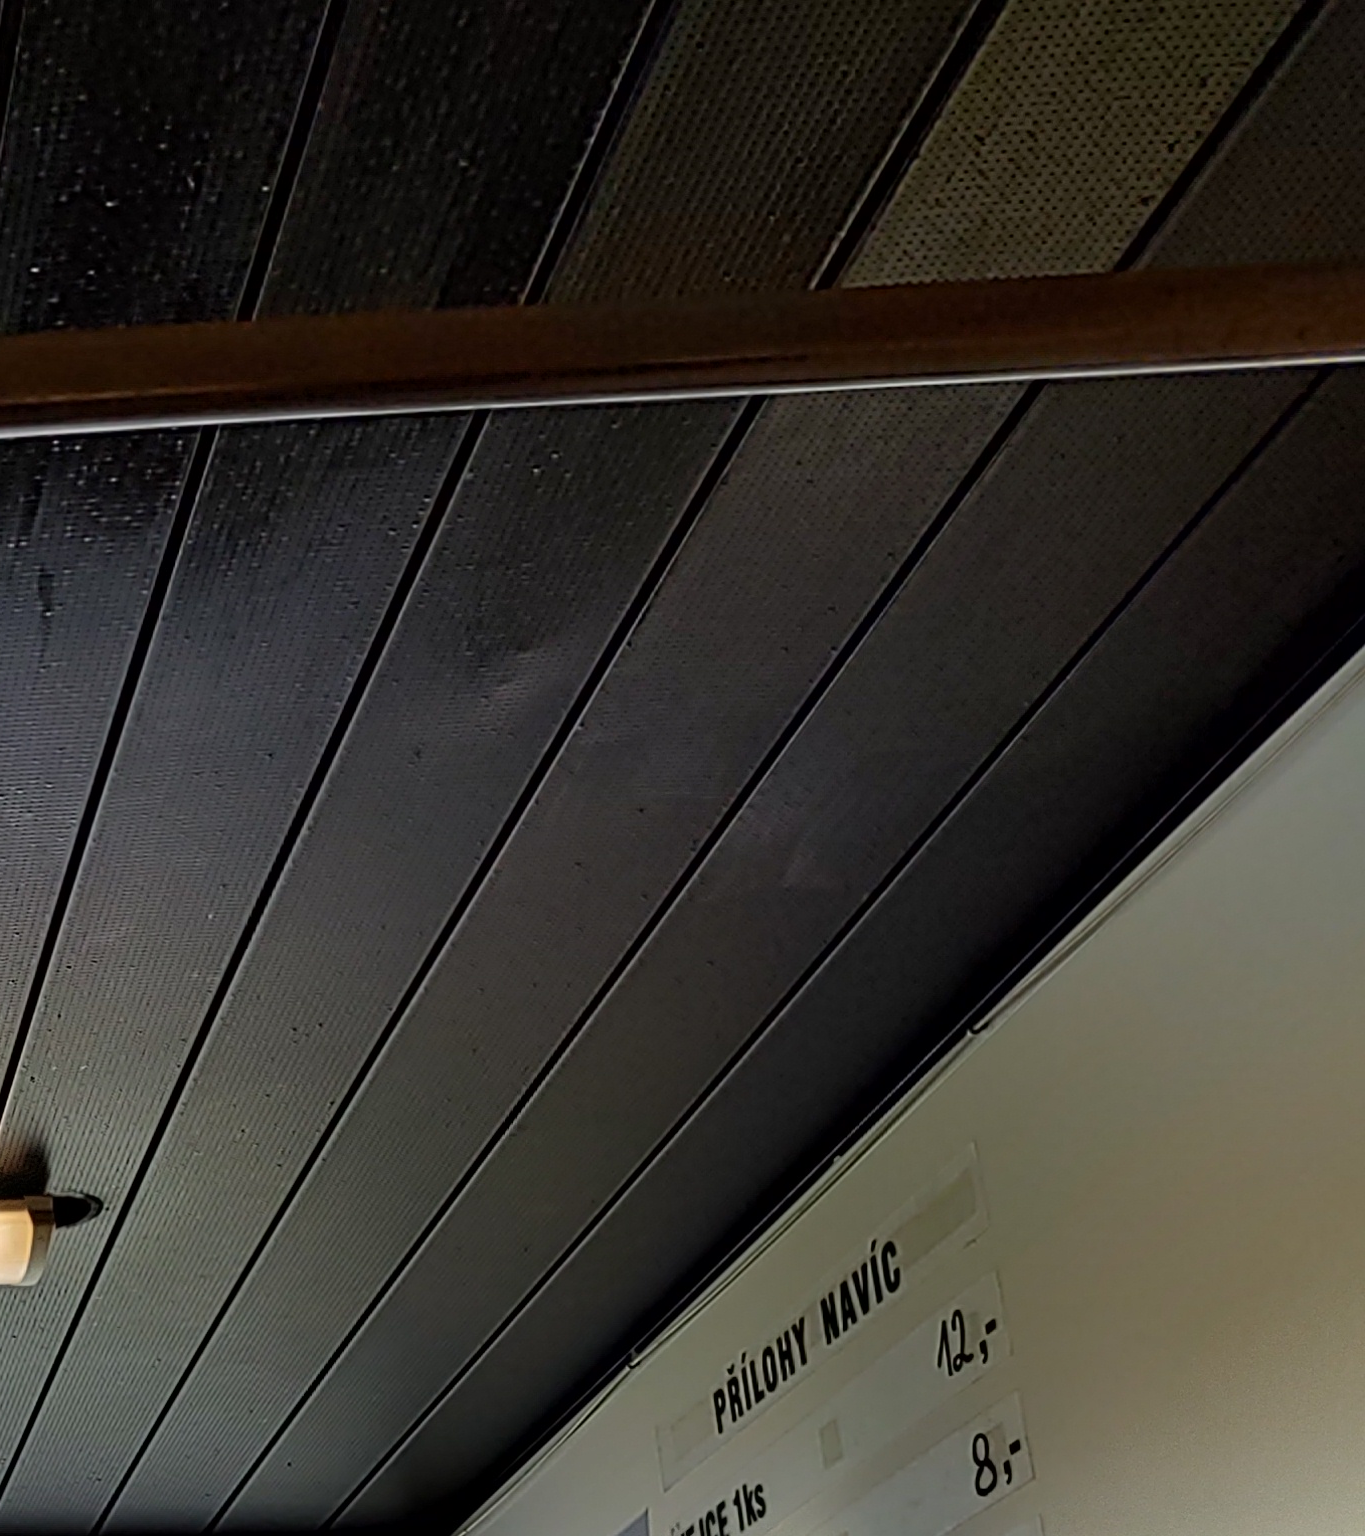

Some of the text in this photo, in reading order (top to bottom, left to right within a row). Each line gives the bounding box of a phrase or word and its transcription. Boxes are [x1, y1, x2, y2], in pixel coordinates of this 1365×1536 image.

[713, 1239, 901, 1434] PŘÍLOHY NAVÍC
[733, 1483, 767, 1533] 1ks
[937, 1309, 997, 1377] 12,-
[972, 1433, 1021, 1497] 8,-
